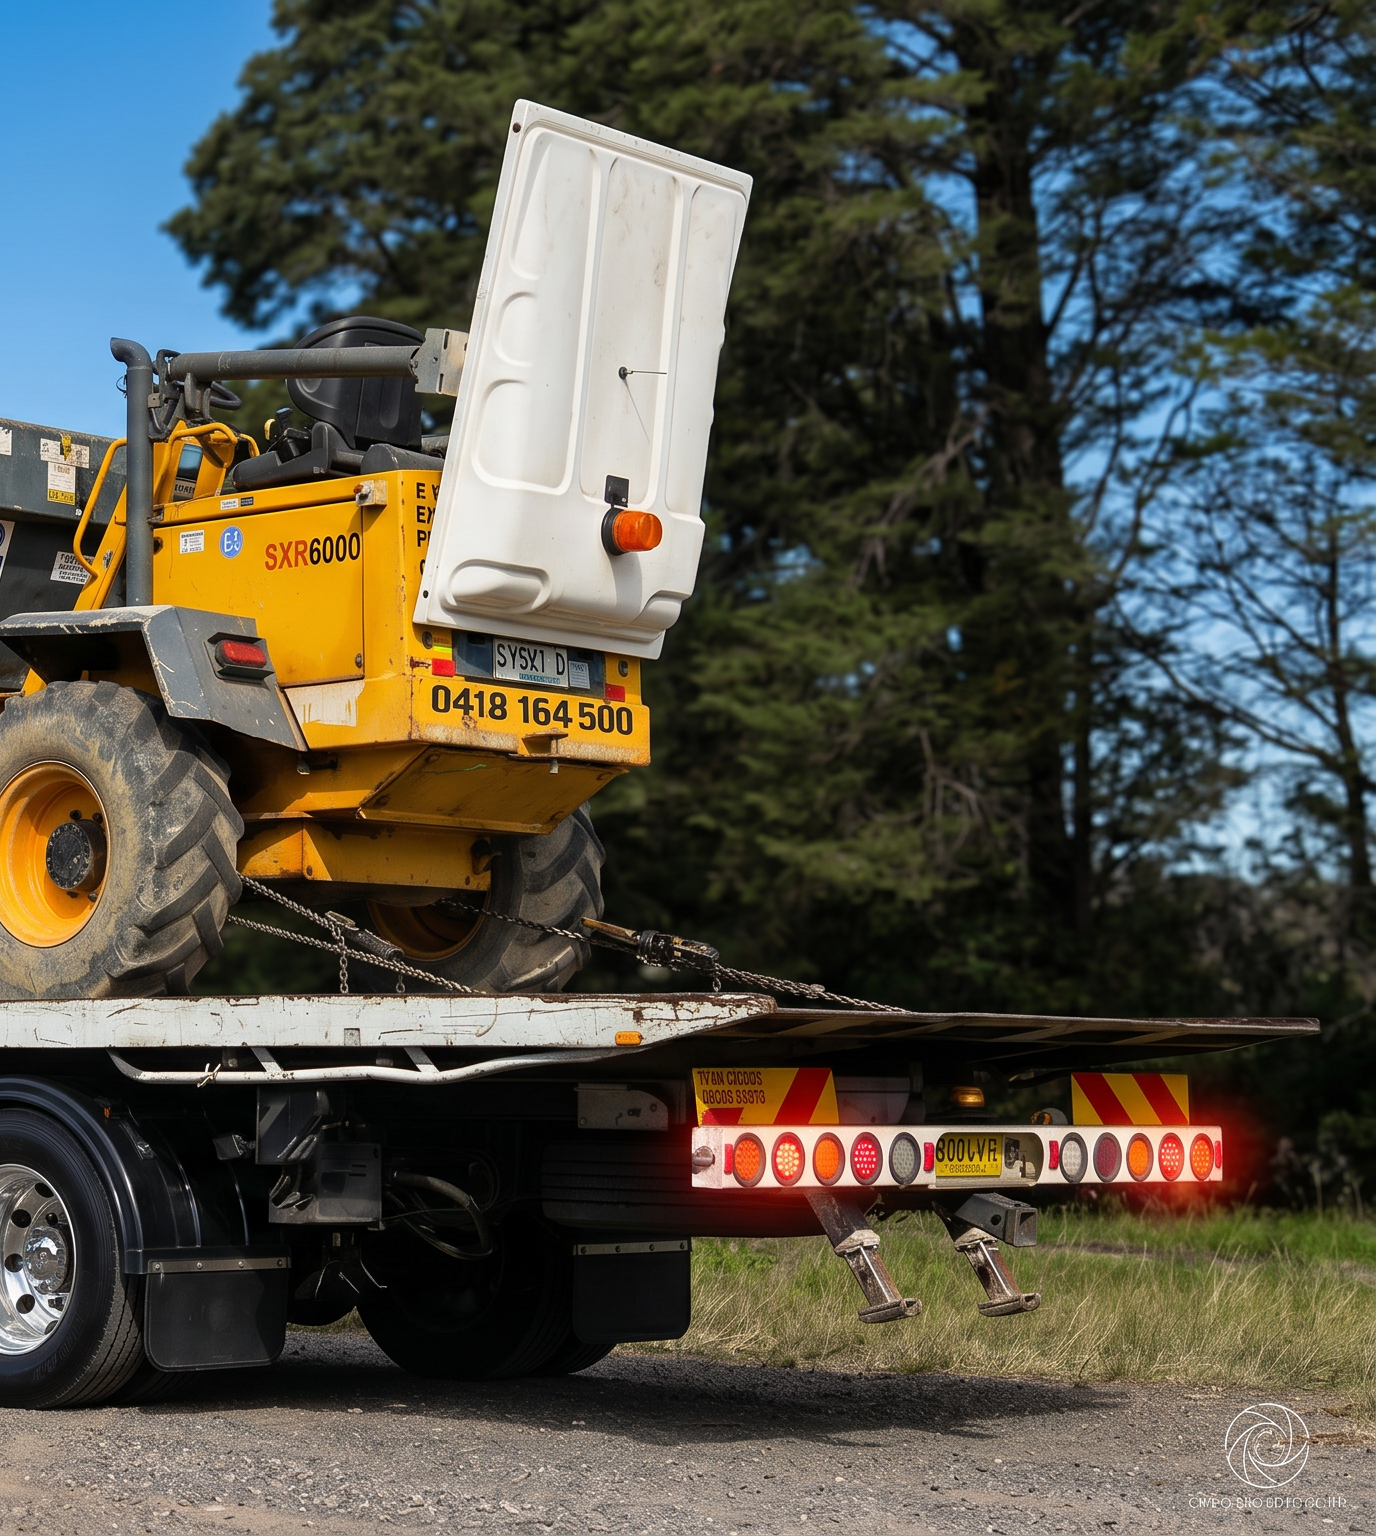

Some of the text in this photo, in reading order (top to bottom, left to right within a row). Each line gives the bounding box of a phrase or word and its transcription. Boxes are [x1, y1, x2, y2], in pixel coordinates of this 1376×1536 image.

[264, 531, 361, 571] SXR6000
[431, 684, 633, 736] 0418 164 500
